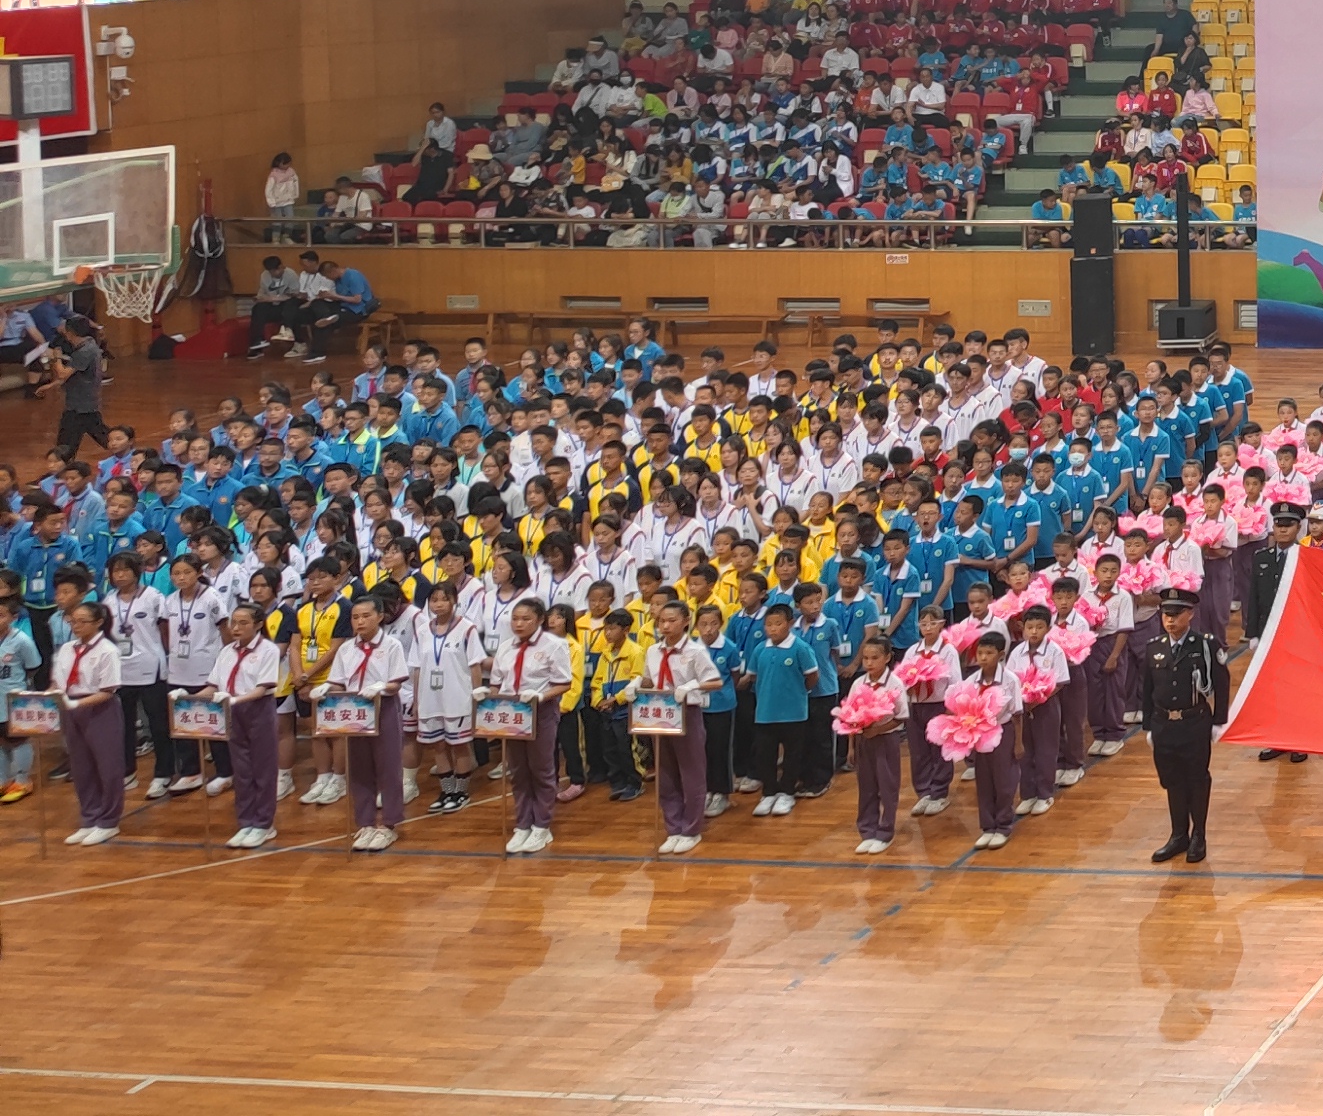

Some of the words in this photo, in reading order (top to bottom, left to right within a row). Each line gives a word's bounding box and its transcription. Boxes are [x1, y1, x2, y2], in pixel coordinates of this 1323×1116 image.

[180, 711, 219, 725] 永仁县
[323, 708, 368, 722] 姚安县
[483, 711, 525, 725] 牟定县
[638, 706, 675, 719] 楚雄市
